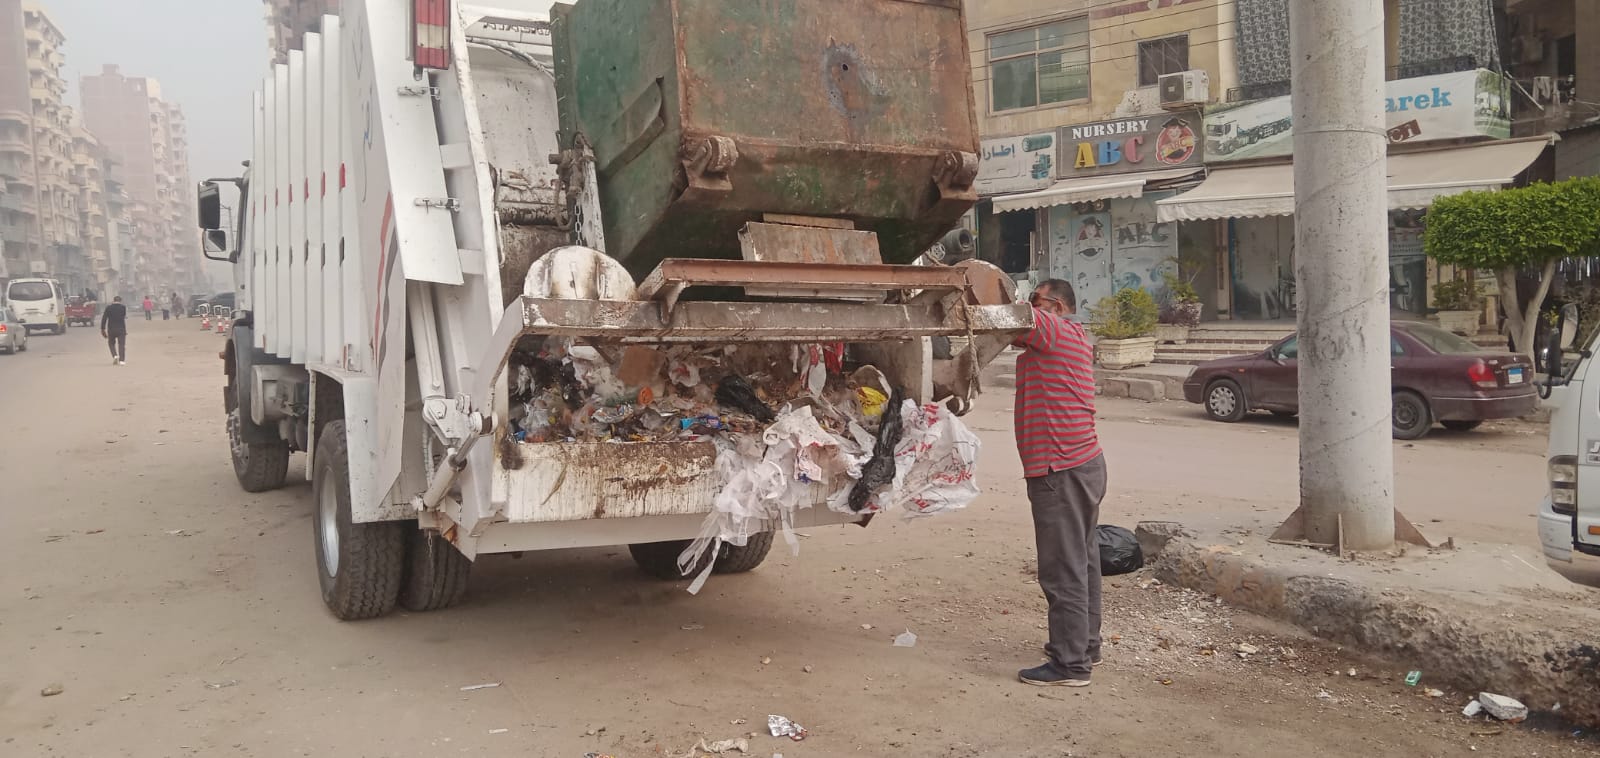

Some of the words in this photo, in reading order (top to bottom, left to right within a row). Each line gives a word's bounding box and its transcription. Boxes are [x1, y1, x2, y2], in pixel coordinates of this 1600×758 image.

[1385, 87, 1452, 112] arek
[1072, 120, 1149, 139] NURSERY
[1074, 136, 1144, 169] ABC
